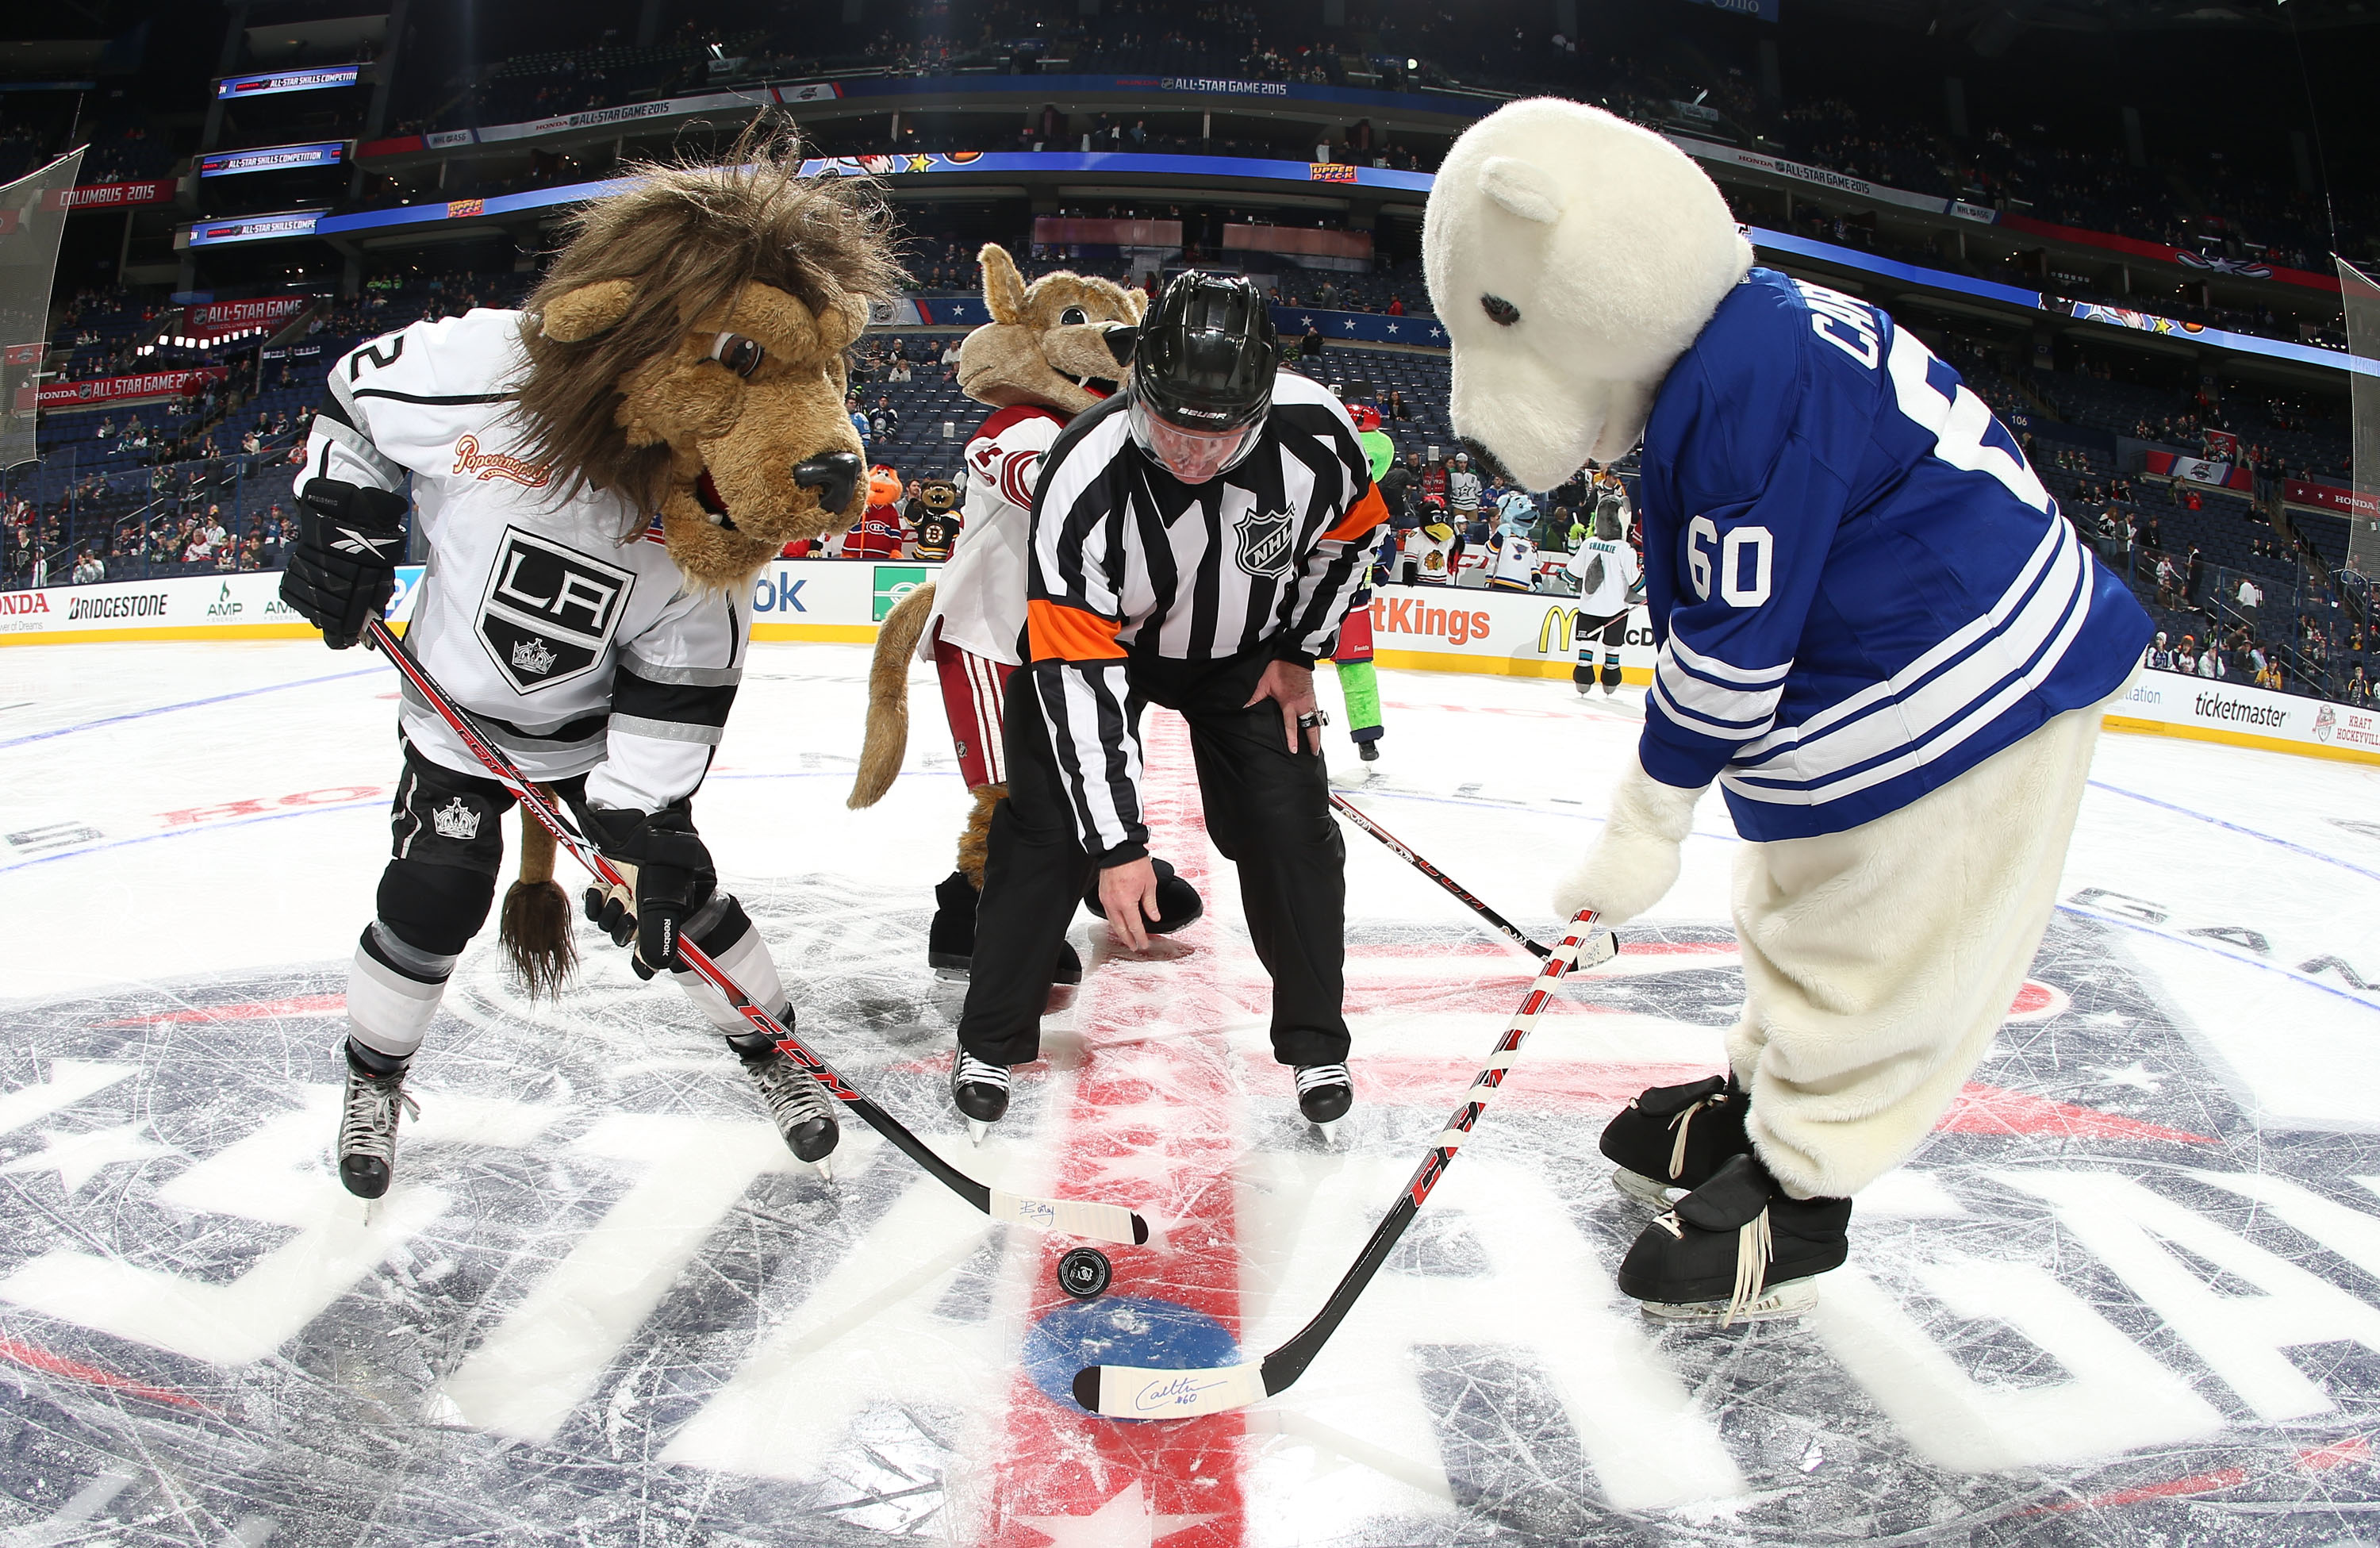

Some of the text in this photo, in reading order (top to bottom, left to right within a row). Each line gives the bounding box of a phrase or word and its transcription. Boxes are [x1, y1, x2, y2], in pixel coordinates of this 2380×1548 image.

[270, 78, 299, 88] ALL-STAR
[299, 75, 321, 85] SKILLS
[1175, 79, 1226, 92] ALL-STAR
[1229, 81, 1260, 94] GAME
[1261, 83, 1287, 95] 2015
[536, 102, 670, 131] HONDA ALL-STAR GAME 2015
[228, 158, 257, 169] ALL-STAR
[257, 155, 278, 166] SKILLS
[278, 152, 322, 163] COMPETITION
[1312, 164, 1354, 175] UPPER
[1738, 155, 1871, 195] HONDA ALL-STAR GAME 2015
[60, 185, 155, 206] COLUMBUS 2015
[449, 200, 483, 213] UPPER
[241, 222, 271, 235] ALL-STAR
[271, 221, 293, 231] SKILLS
[208, 299, 302, 323] ALL-STAR GAME
[36, 389, 78, 401] HONDA
[92, 382, 116, 398] ALL
[116, 379, 142, 396] STAR
[144, 375, 175, 392] GAME
[1177, 407, 1227, 421] BAUER
[2011, 415, 2028, 426] 106
[2334, 494, 2376, 511] HONDA
[1253, 525, 1292, 567] NHL
[1588, 541, 1618, 555] SHARKIE
[1687, 514, 1774, 609] 60
[498, 549, 617, 629] LA
[0, 593, 50, 616] NDA
[68, 593, 169, 621] BRIDGESTONE
[207, 602, 244, 617] AMP
[2194, 691, 2287, 728] ticketmaster
[2348, 715, 2373, 730] KRAFT
[2336, 727, 2380, 746] HOCKEYVILL
[520, 795, 573, 847] ULTIMATE
[1418, 859, 1487, 911] CCM
[662, 918, 672, 957] Reebok
[737, 1001, 862, 1102] CCM
